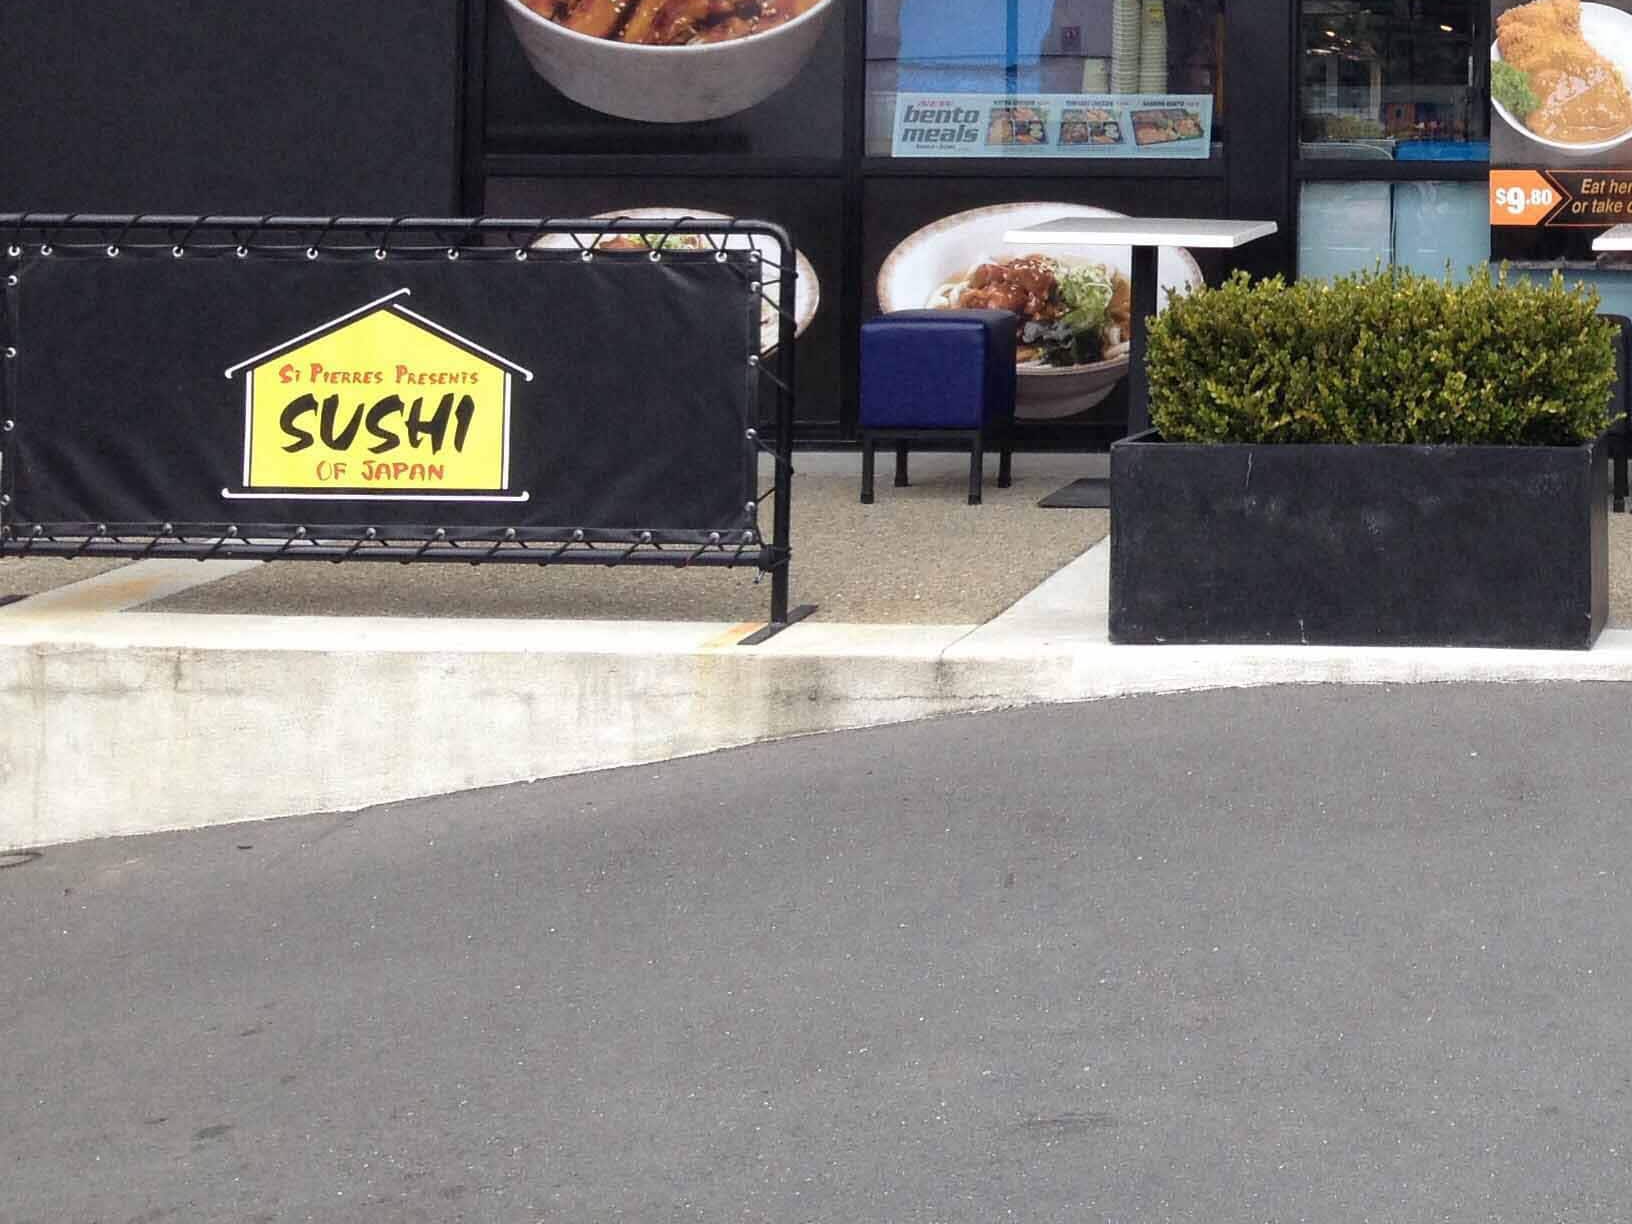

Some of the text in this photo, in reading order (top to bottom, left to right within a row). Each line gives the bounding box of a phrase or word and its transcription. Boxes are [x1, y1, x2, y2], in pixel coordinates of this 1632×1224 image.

[903, 105, 980, 123] bento
[902, 125, 979, 143] meals
[1581, 178, 1606, 194] Eat
[1495, 186, 1552, 214] $9.80
[1572, 200, 1587, 213] or
[1591, 198, 1623, 213] take
[310, 363, 383, 384] PIERRES
[395, 364, 479, 385] PRESENTS
[279, 392, 475, 455] SUSHI
[316, 460, 445, 481] OF JAPAN
